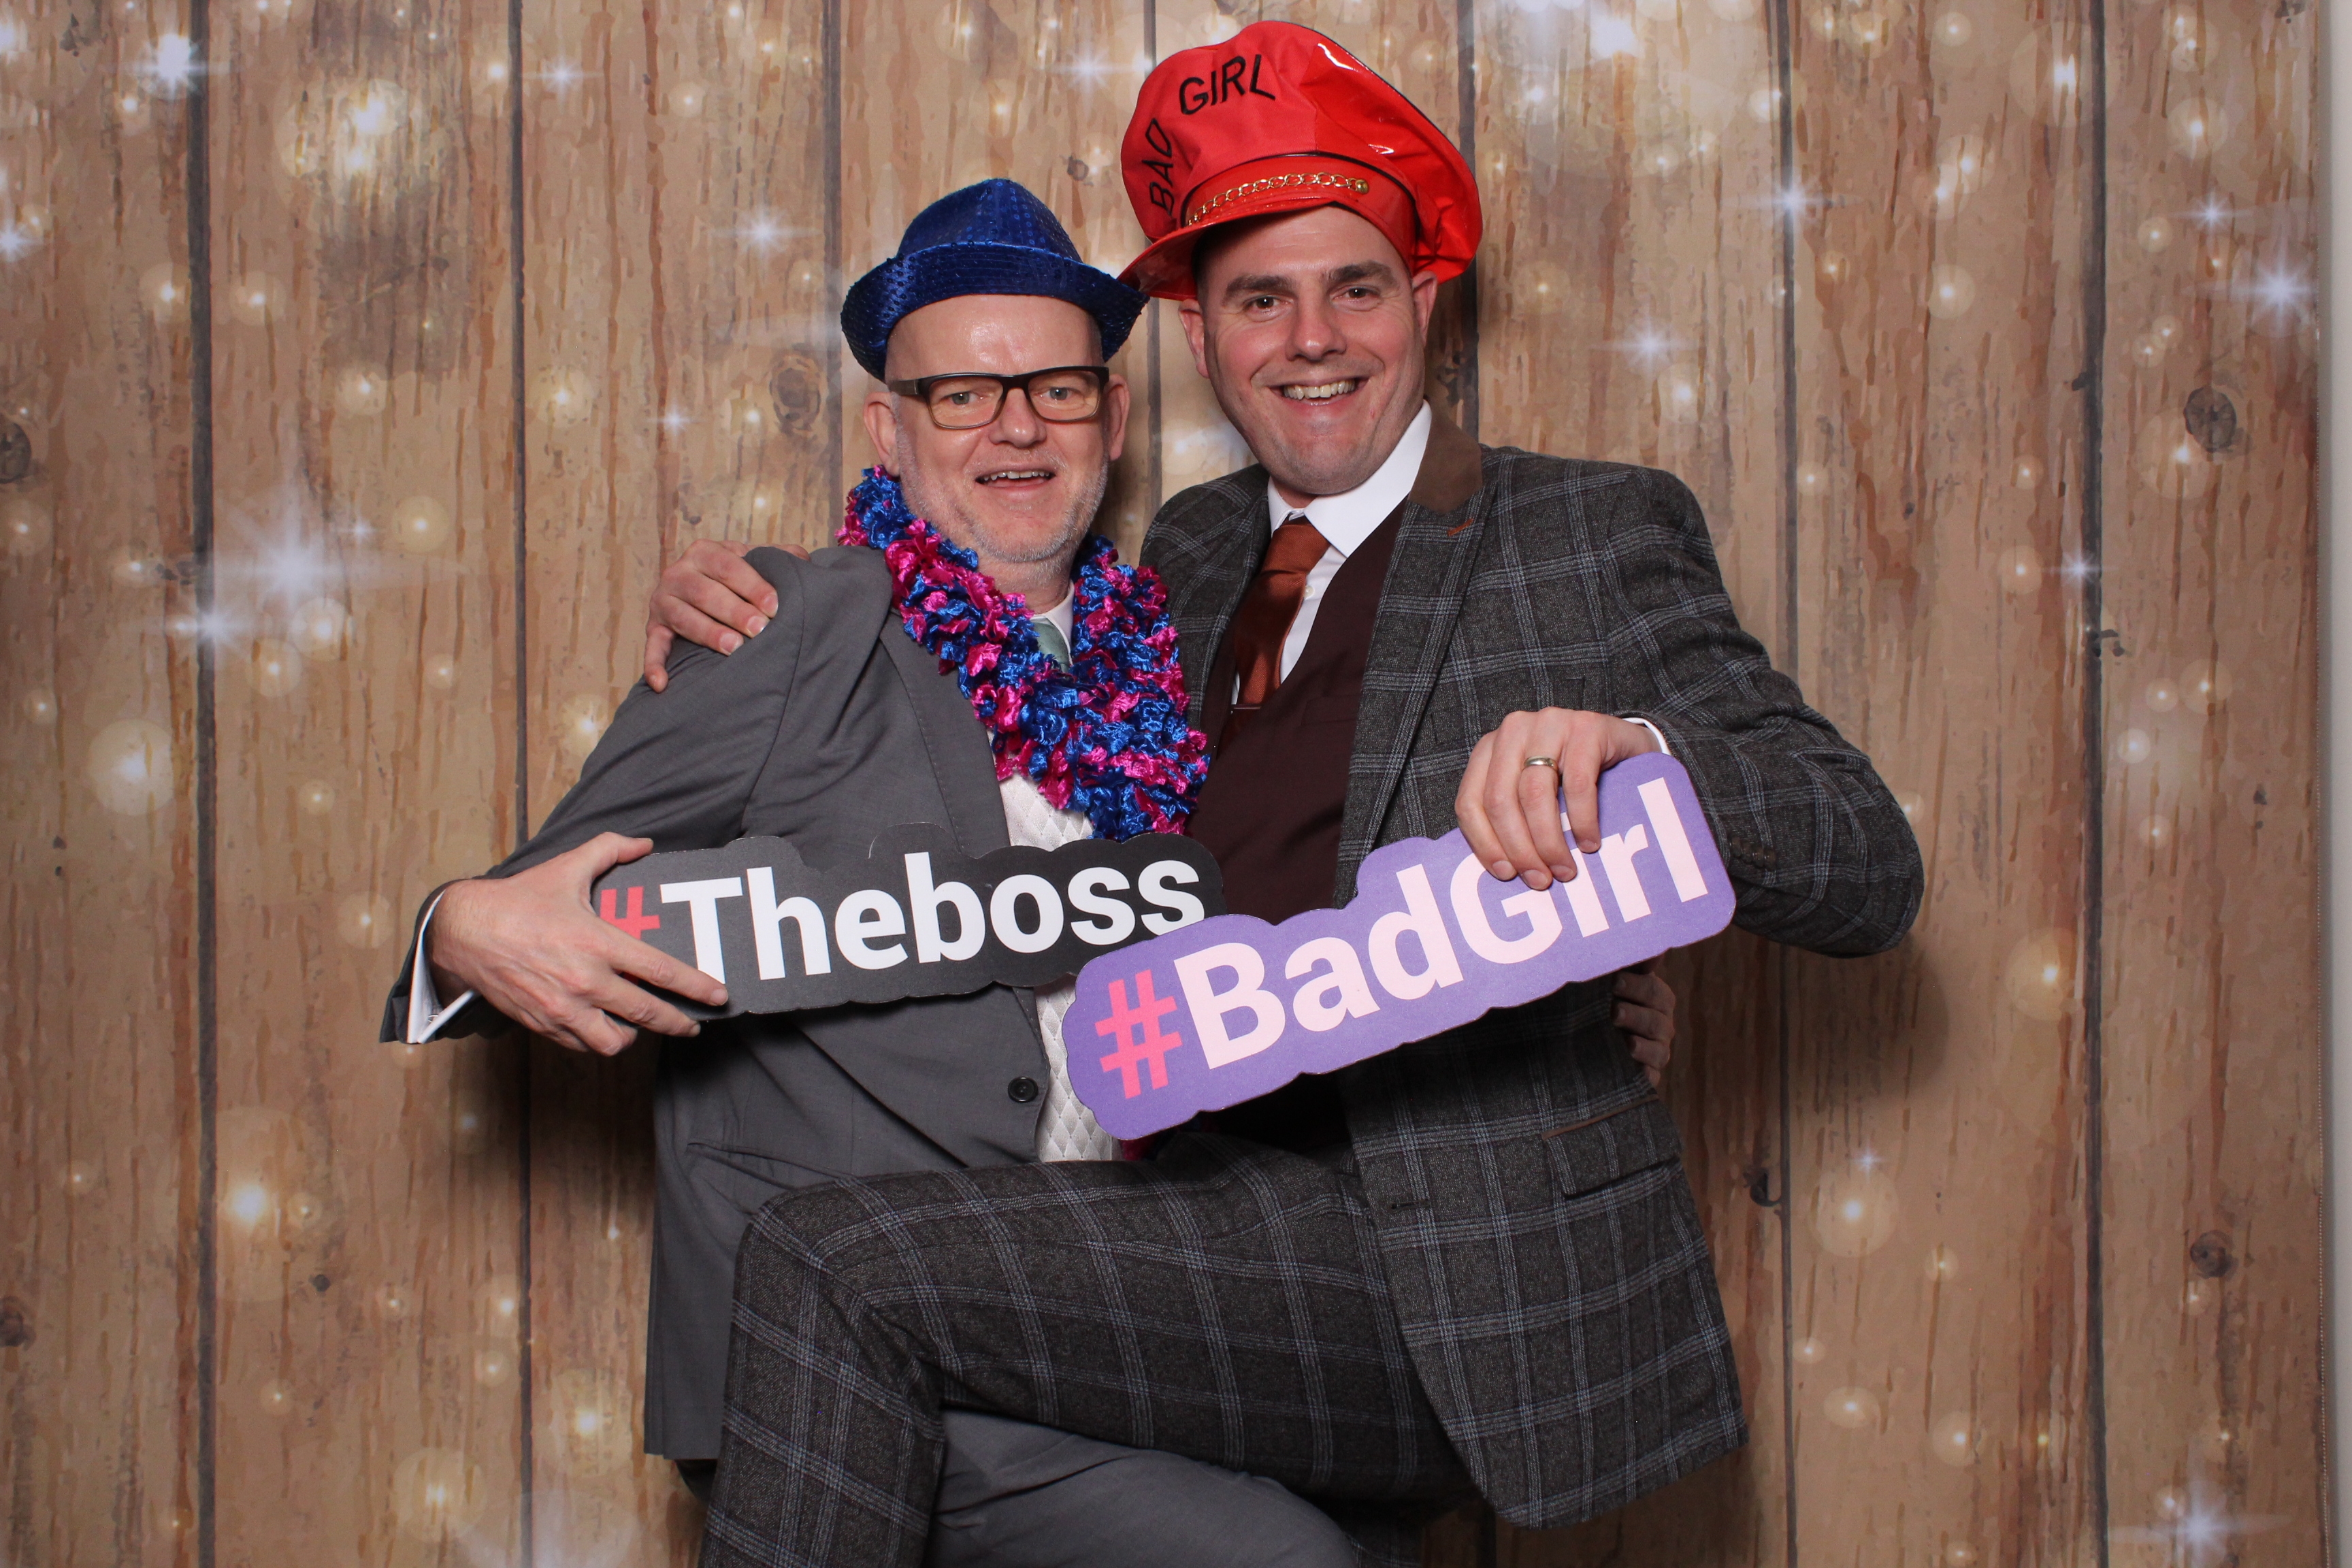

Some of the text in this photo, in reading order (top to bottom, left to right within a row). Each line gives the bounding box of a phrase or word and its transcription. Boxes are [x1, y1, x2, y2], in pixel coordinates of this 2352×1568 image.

[1143, 54, 1275, 216] BAD GIRL
[1094, 777, 1709, 1099] #BadGirl
